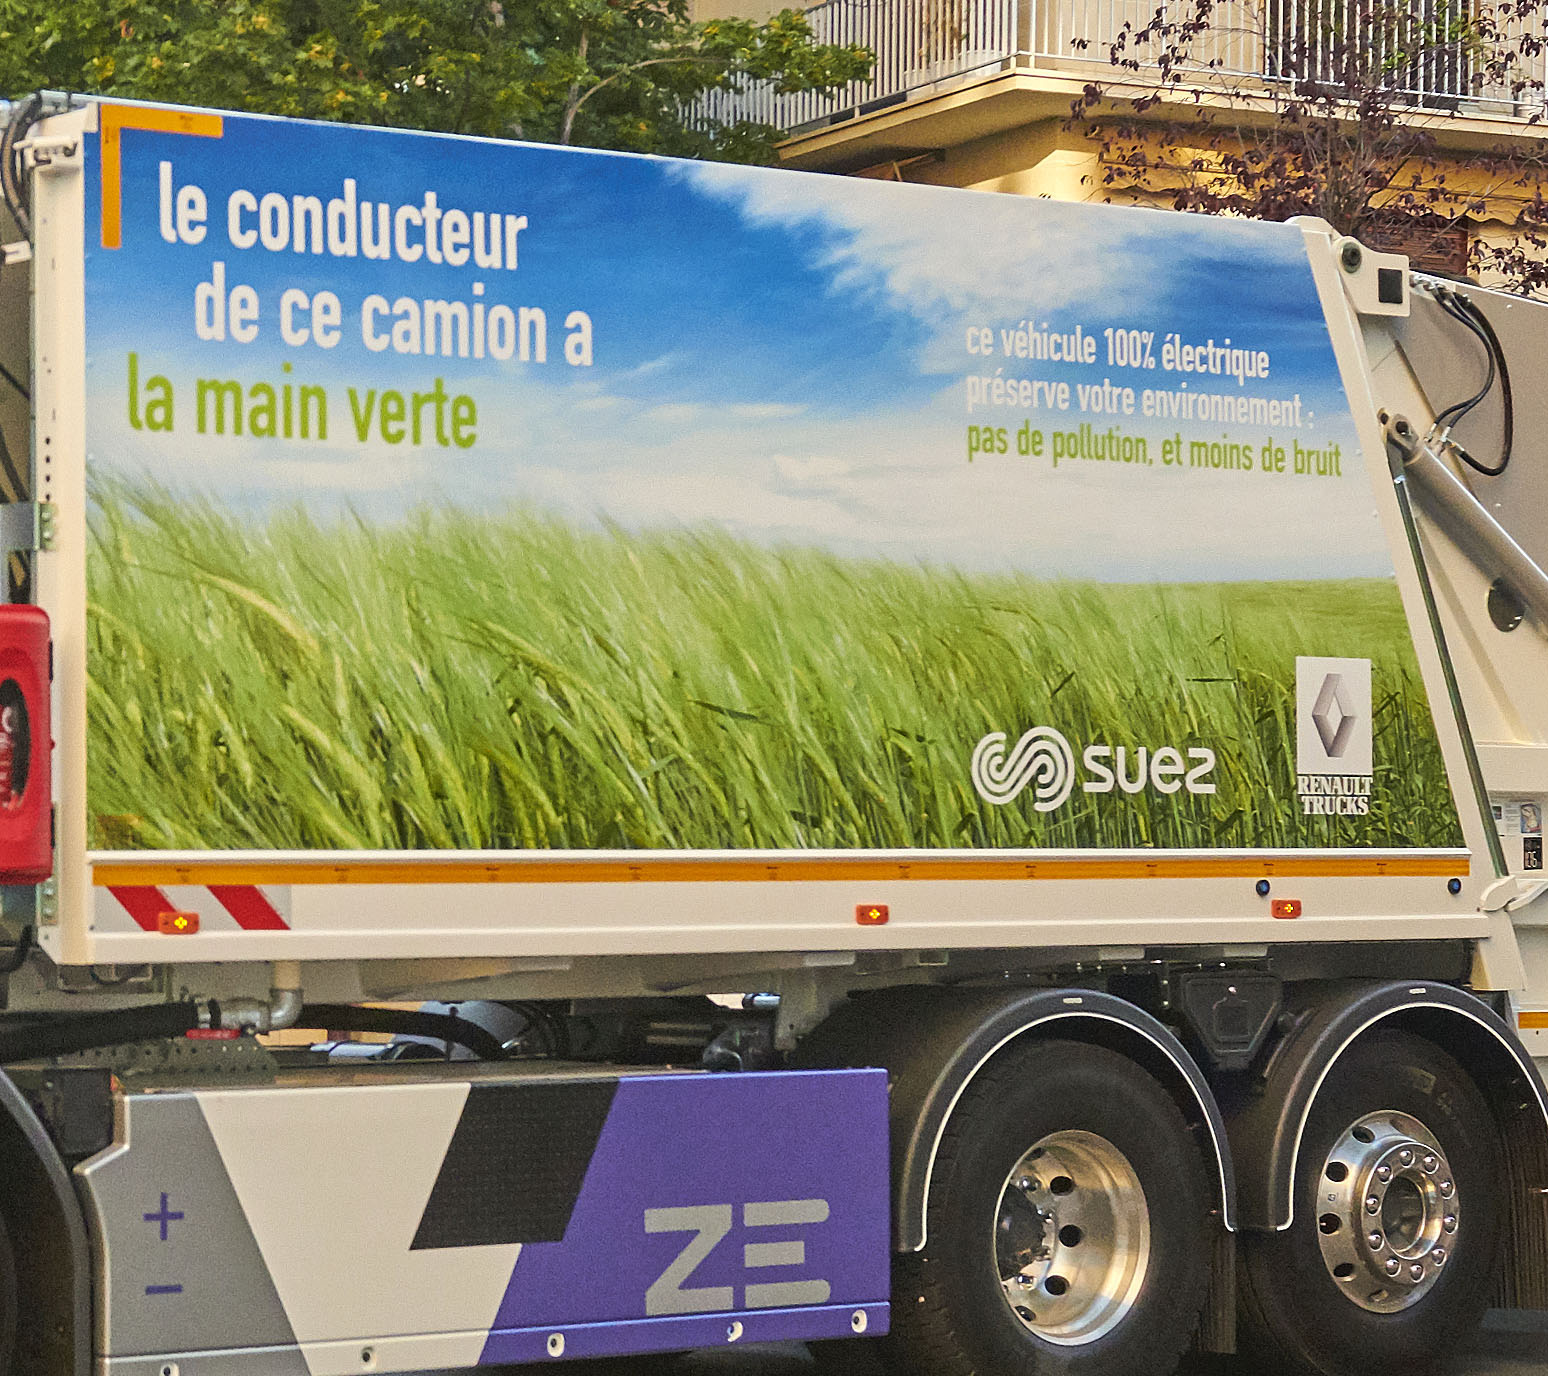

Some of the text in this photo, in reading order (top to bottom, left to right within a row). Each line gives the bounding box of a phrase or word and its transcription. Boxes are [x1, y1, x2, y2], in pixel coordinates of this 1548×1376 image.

[159, 160, 528, 270] le conducteur
[194, 261, 594, 366] de ce camion a
[966, 321, 1270, 386] ce véhicule 100% électrique
[127, 352, 477, 448] la main verte
[966, 368, 1070, 413] préserve
[1078, 378, 1135, 416] votre
[1142, 382, 1302, 428] environnement
[967, 419, 1342, 477] pas de pollution, et moins de bruit
[1297, 775, 1373, 796] RENAULT
[1302, 795, 1370, 816] TRUCKS
[644, 1198, 830, 1316] ZE
